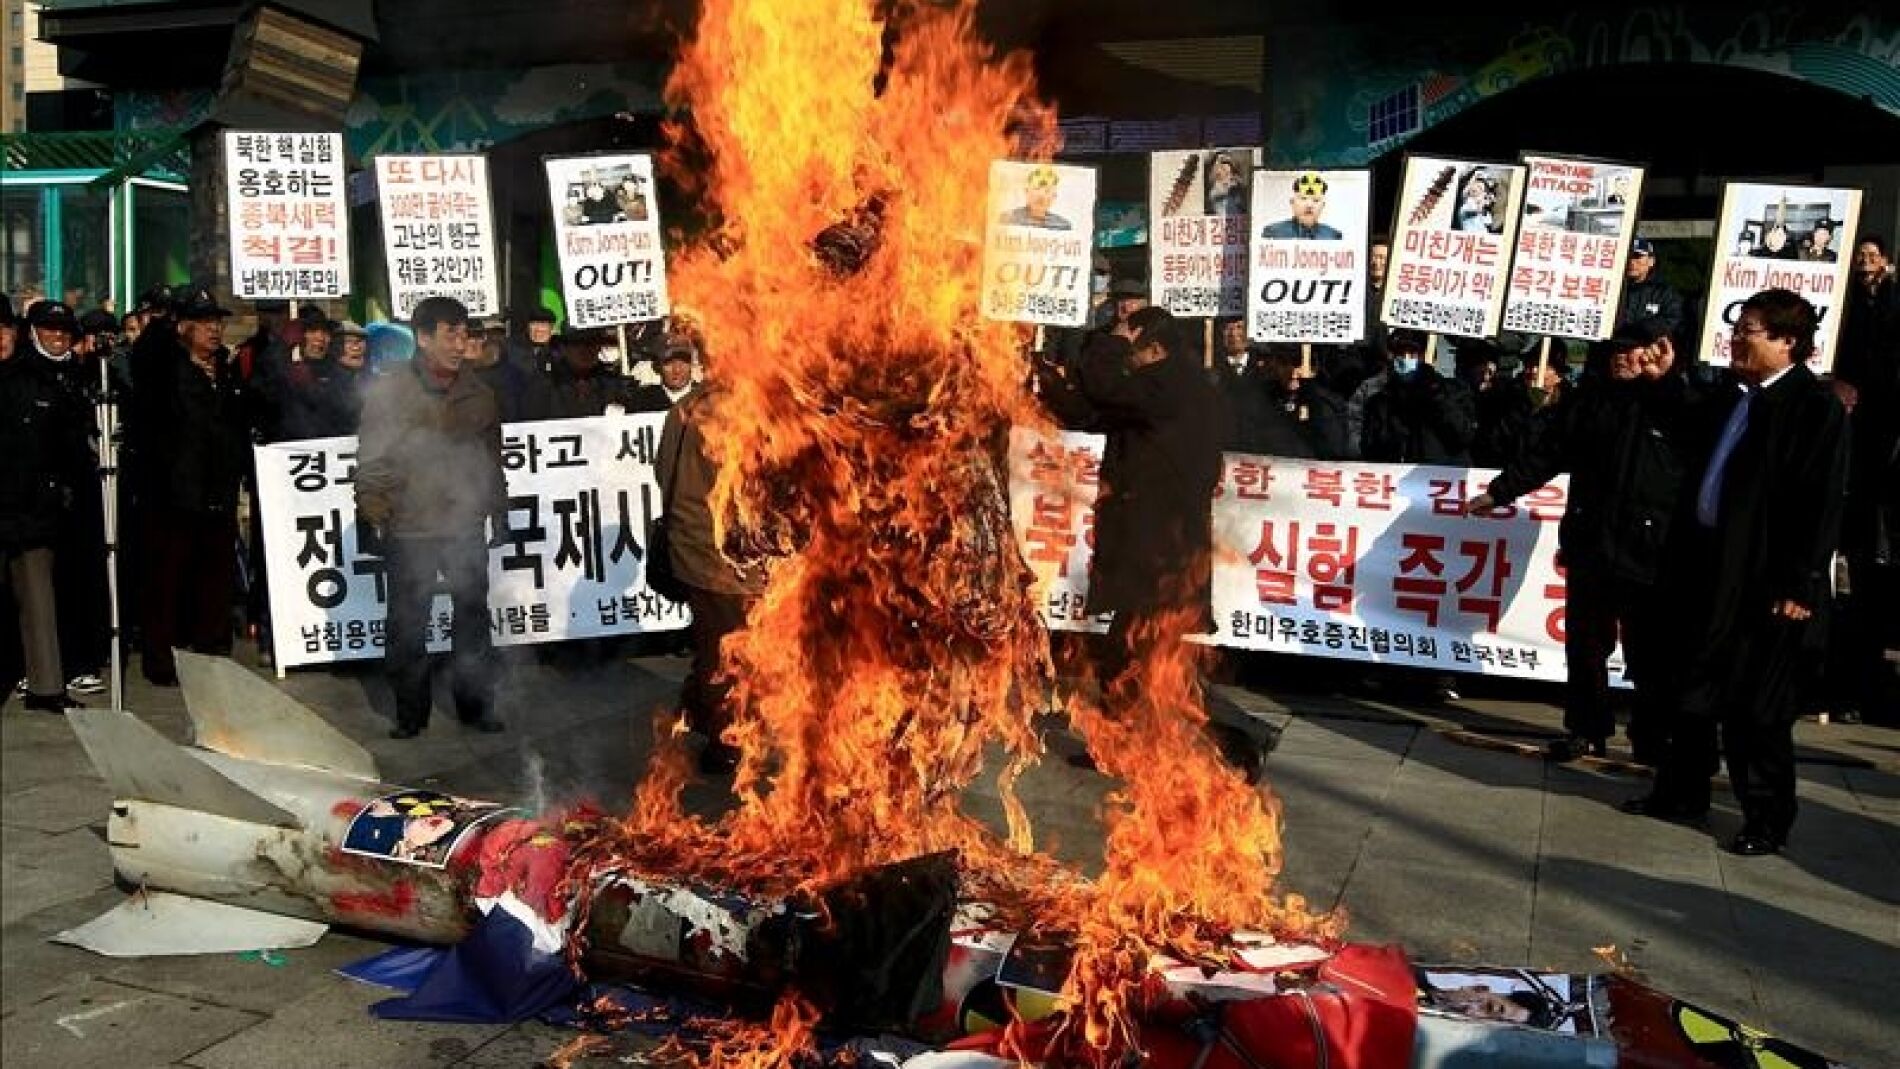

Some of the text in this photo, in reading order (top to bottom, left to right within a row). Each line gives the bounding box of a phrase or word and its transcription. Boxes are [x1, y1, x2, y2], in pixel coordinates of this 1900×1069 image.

[237, 135, 332, 164] 북한 핵 실험
[237, 168, 333, 197] 옹호하는
[387, 158, 476, 186] 또 다시
[240, 201, 336, 230] 종북세력
[394, 222, 481, 250] 고난의 행군
[1163, 218, 1207, 247] 미친개
[1406, 229, 1499, 266] 미친개는
[1258, 243, 1355, 276] Kim Jong-un
[1520, 229, 1619, 269] 북한 핵 실험
[241, 268, 338, 295] 납북자가족모임
[574, 259, 652, 291] OUT!
[996, 262, 1080, 291] OUT!
[1514, 266, 1611, 304] 즉각 보복!
[1723, 261, 1834, 293] Kim Jong-un
[1260, 277, 1353, 305] OUT!
[1302, 467, 1397, 511] 북한
[1247, 520, 1360, 616] 실험
[1392, 534, 1512, 635] 즉각
[1231, 609, 1542, 671] 한미우호증진협의회 한국본부
